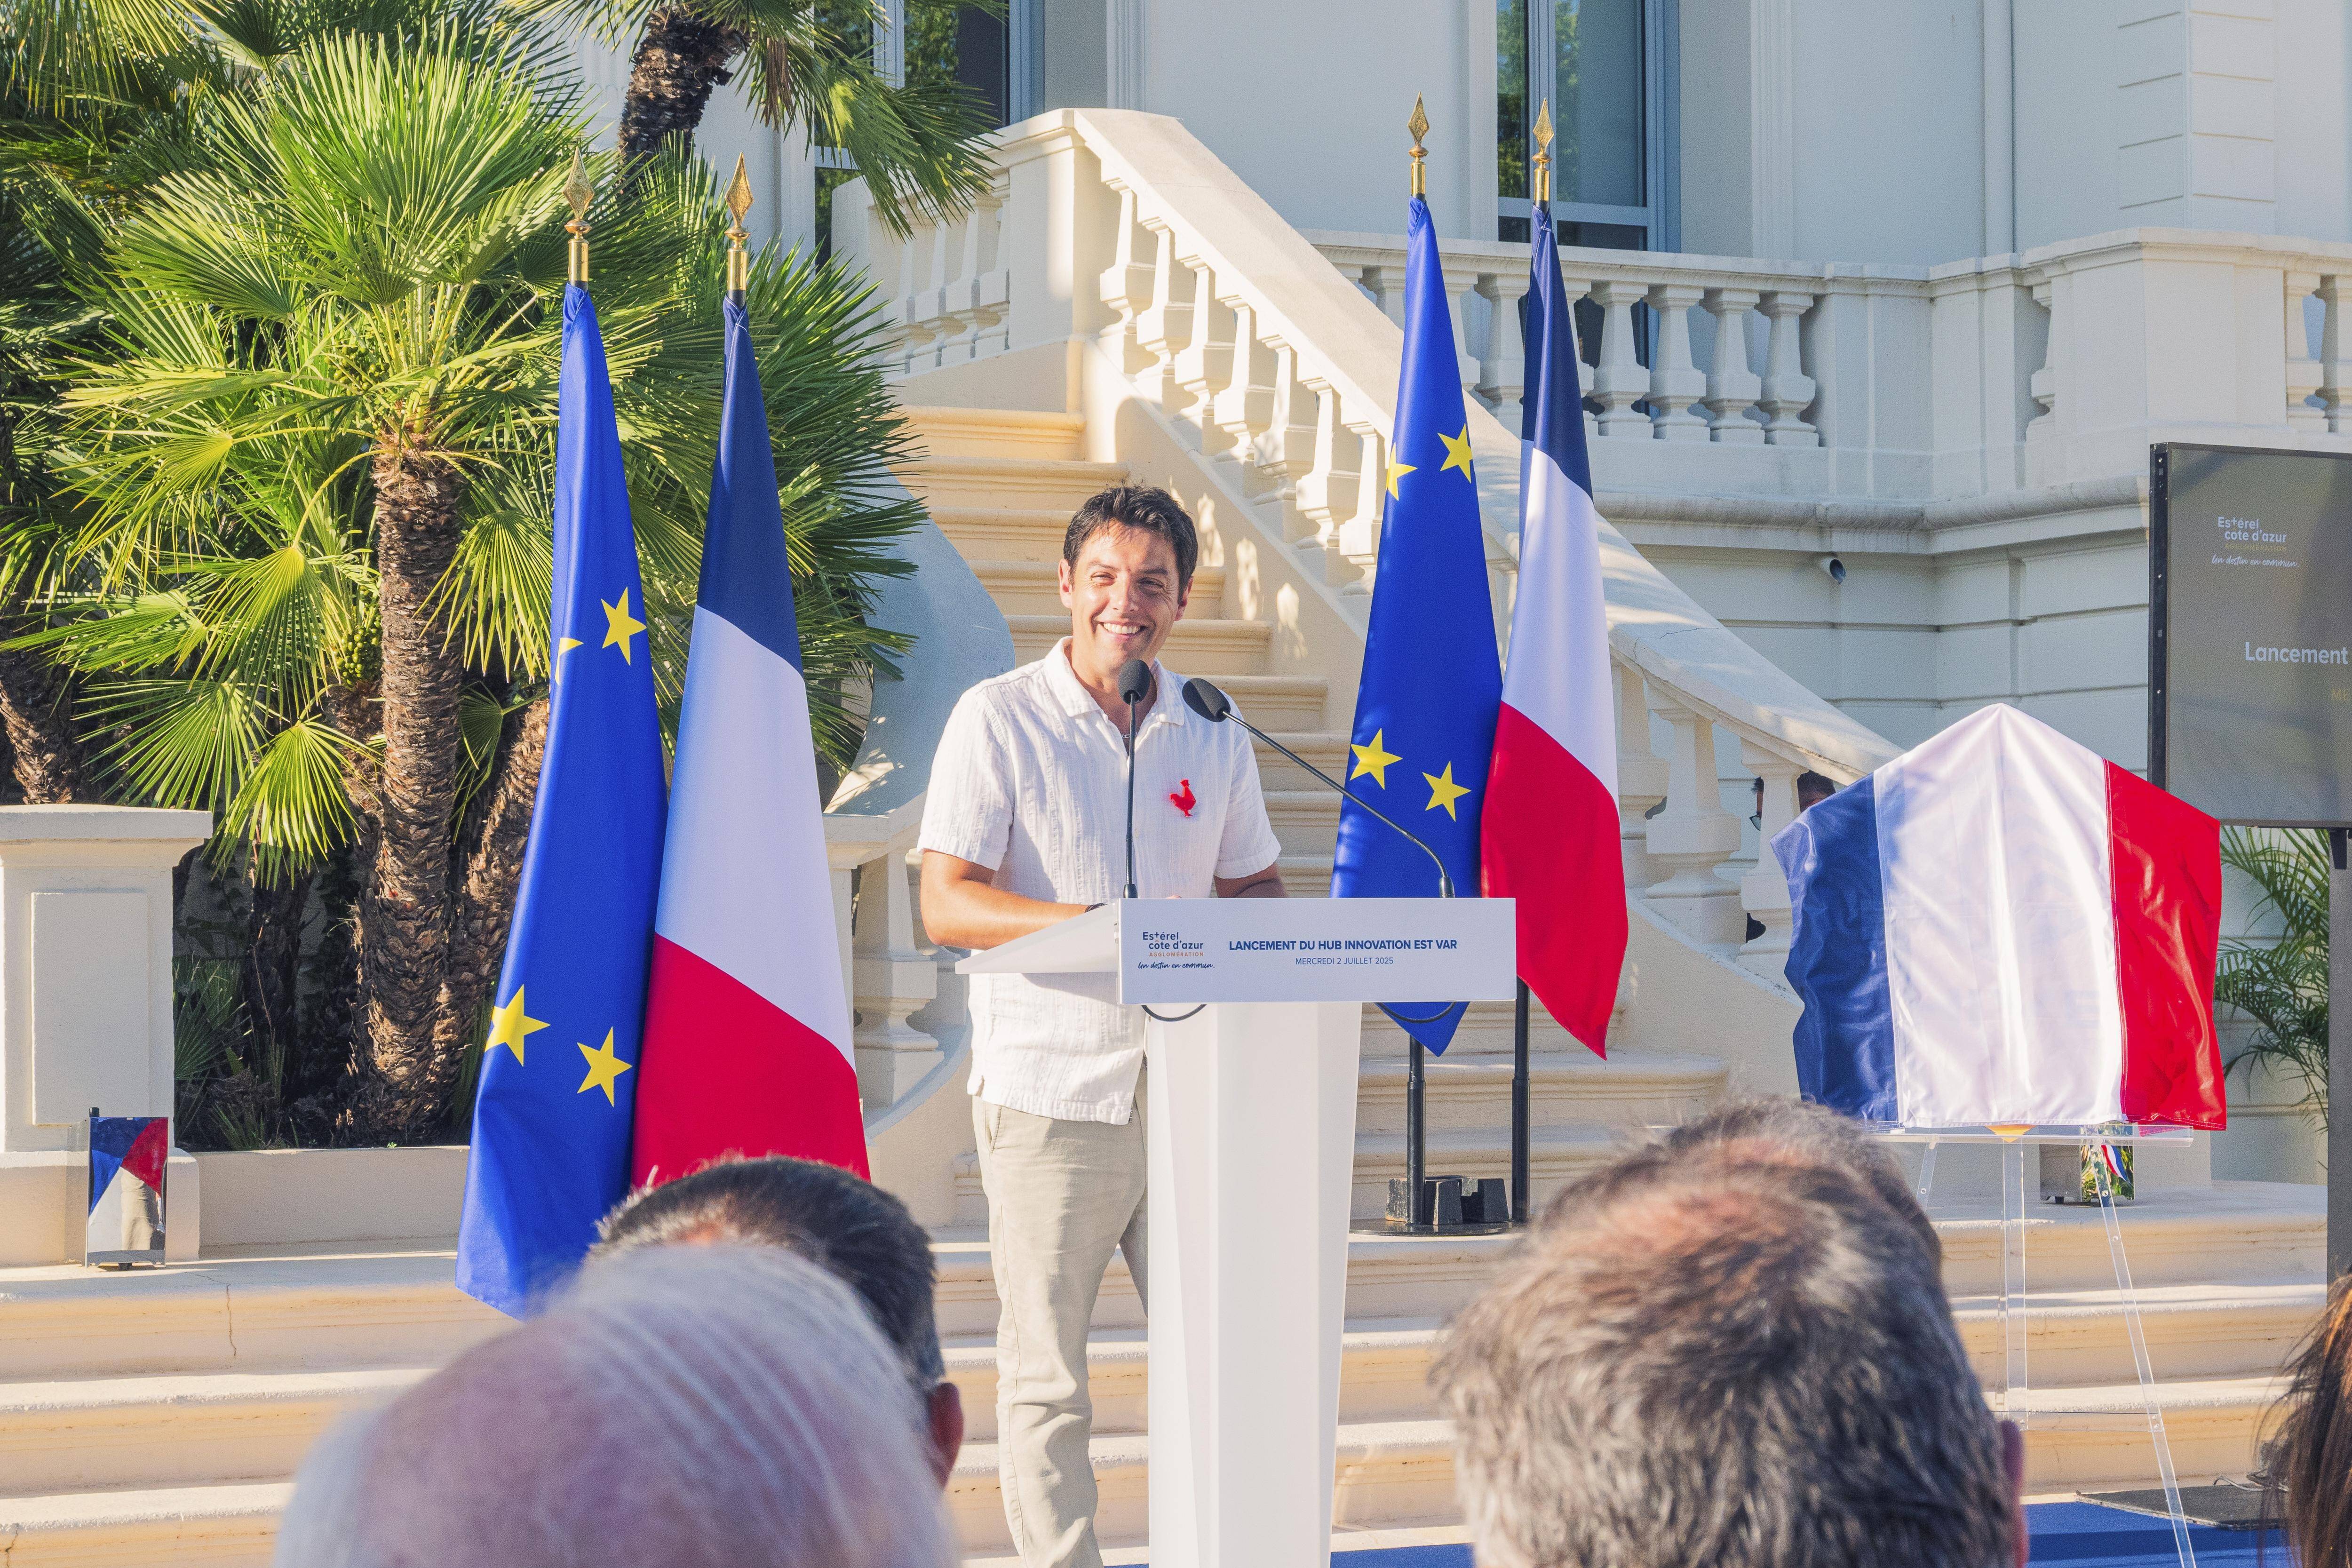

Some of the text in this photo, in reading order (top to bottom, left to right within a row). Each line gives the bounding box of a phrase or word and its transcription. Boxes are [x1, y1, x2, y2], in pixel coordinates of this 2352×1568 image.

[2252, 529, 2287, 542] d'azur
[2226, 555, 2249, 565] destin
[2245, 642, 2349, 665] Lancement
[1143, 931, 1179, 940] Estérel
[1149, 940, 1204, 949] côte d'azur
[1229, 939, 1457, 950] LANCEMENT DU HUB INNOVATION EST VAR
